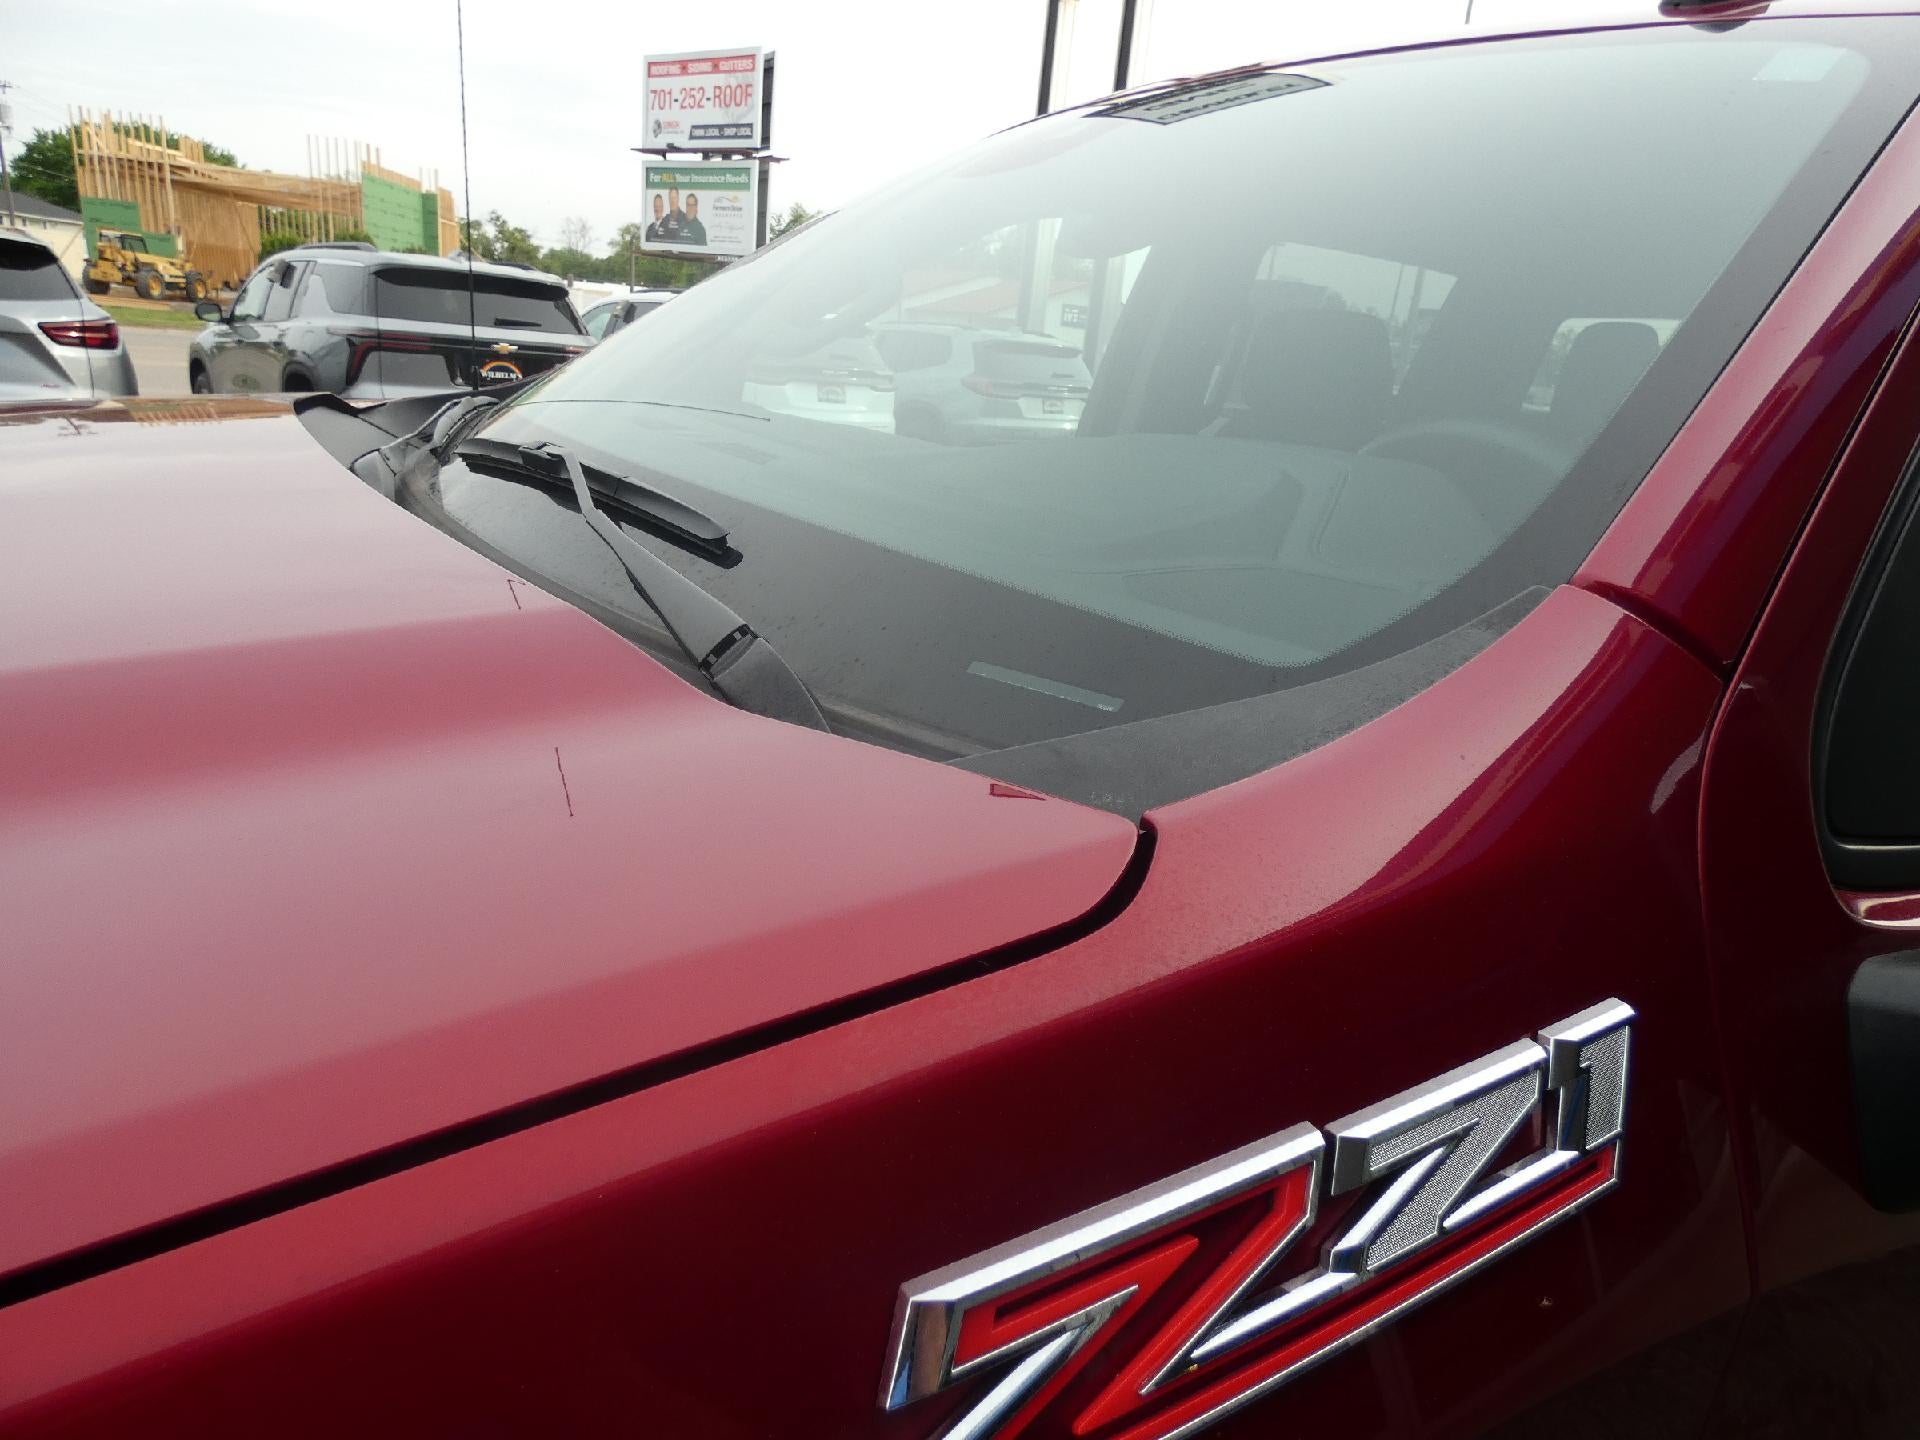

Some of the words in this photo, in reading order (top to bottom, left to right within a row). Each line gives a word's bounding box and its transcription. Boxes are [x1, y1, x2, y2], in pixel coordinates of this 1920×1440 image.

[650, 83, 753, 110] 701-252-ROOF
[650, 173, 661, 182] For
[675, 173, 691, 183] Your
[691, 173, 725, 183] Insurance
[726, 173, 749, 183] Needs
